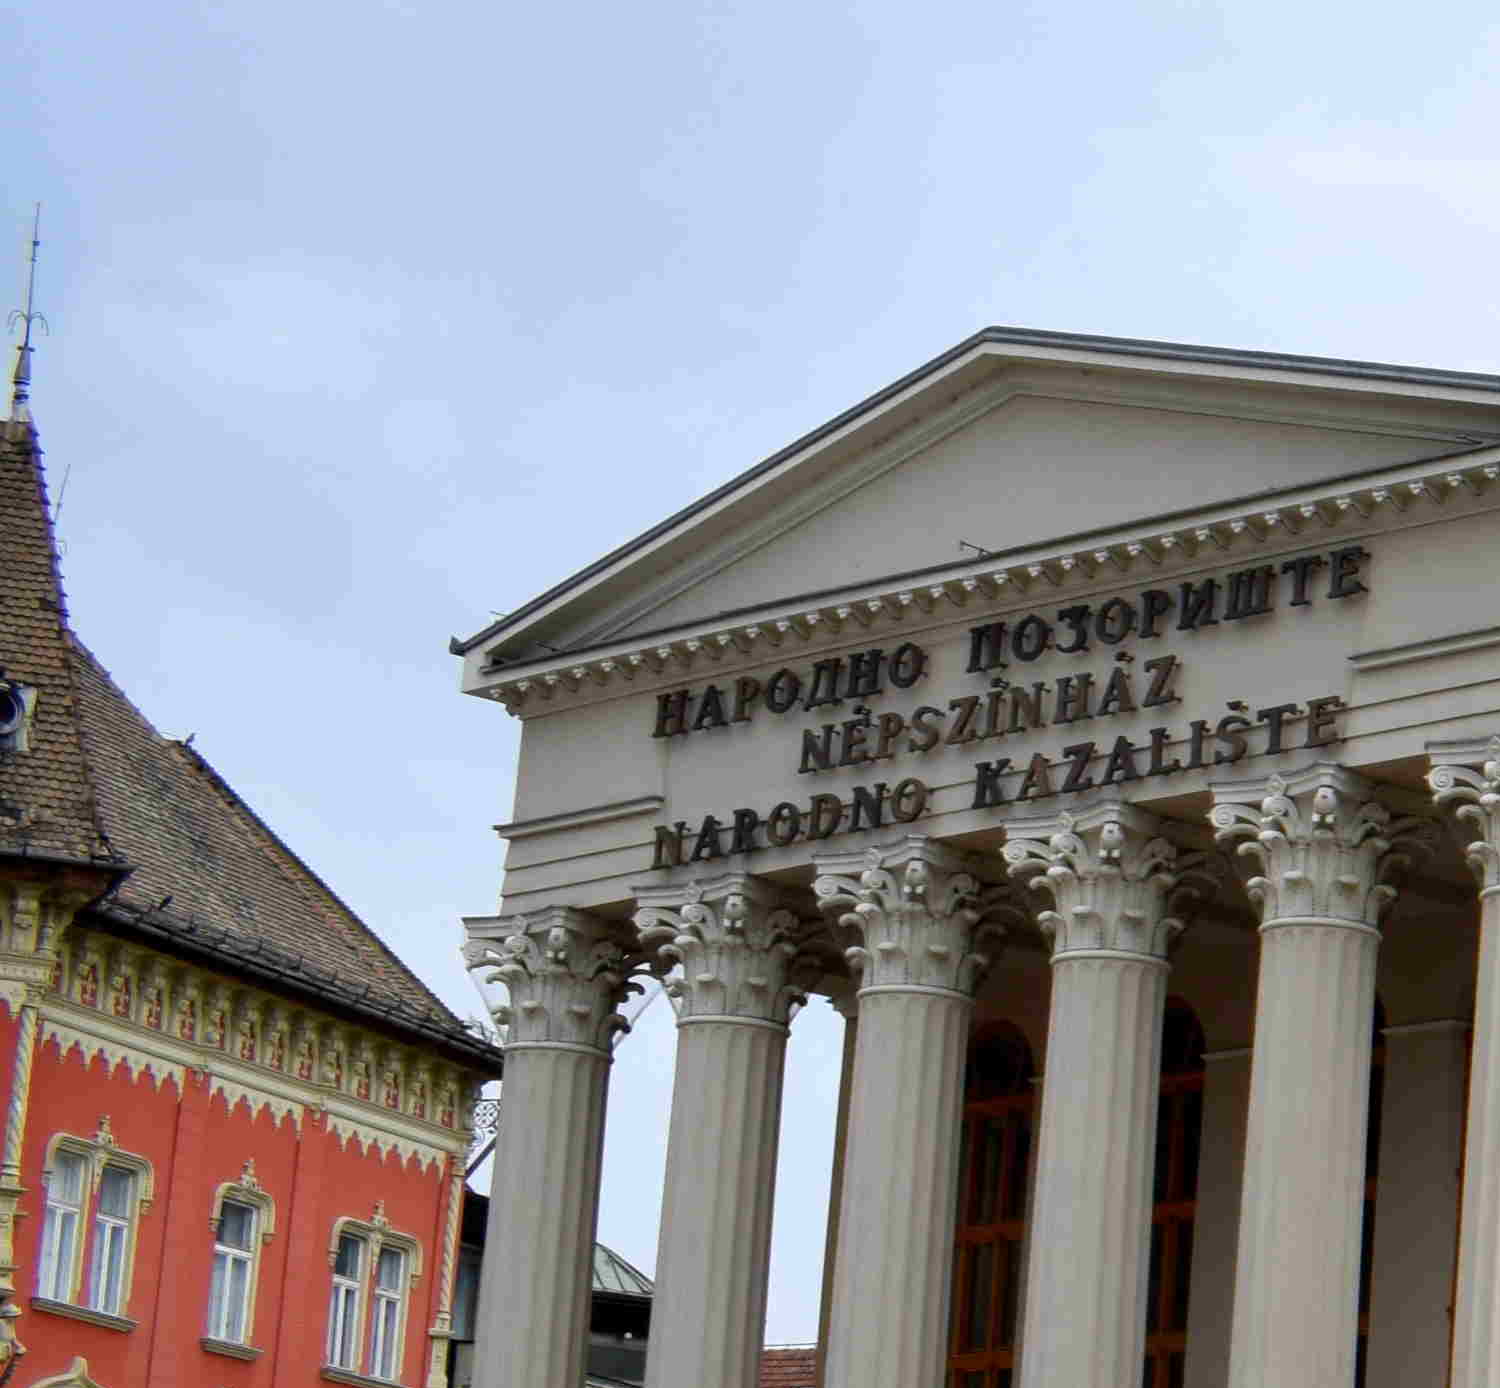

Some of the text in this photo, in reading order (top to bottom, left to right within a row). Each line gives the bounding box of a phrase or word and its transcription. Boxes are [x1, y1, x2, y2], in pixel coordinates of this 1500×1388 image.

[652, 545, 1369, 738] НАРОДНО ПОЗОРИШТЕ
[798, 651, 1183, 774] NÉPSZÍNHÁZ
[651, 695, 1345, 869] NARODNO KAZALIŠTE
